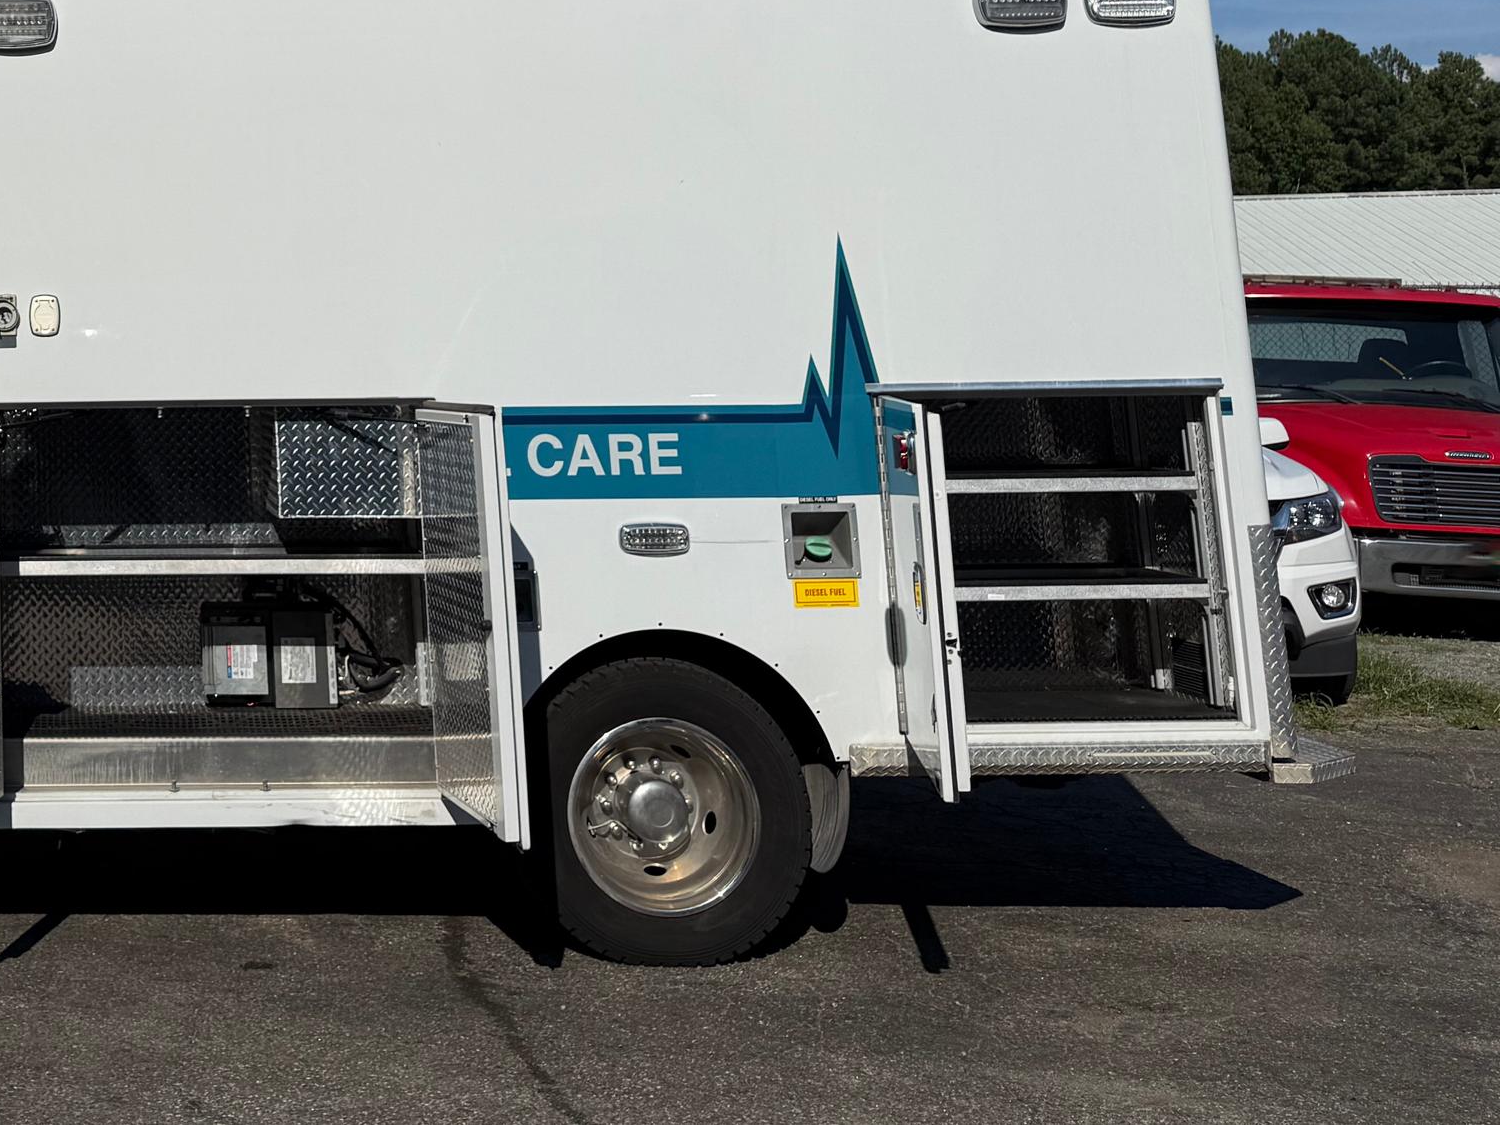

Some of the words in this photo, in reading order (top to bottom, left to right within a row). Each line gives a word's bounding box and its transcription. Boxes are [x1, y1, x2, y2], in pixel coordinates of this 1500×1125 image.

[527, 433, 683, 477] CARE
[804, 588, 828, 597] DIESEL
[829, 587, 846, 596] FUEL
